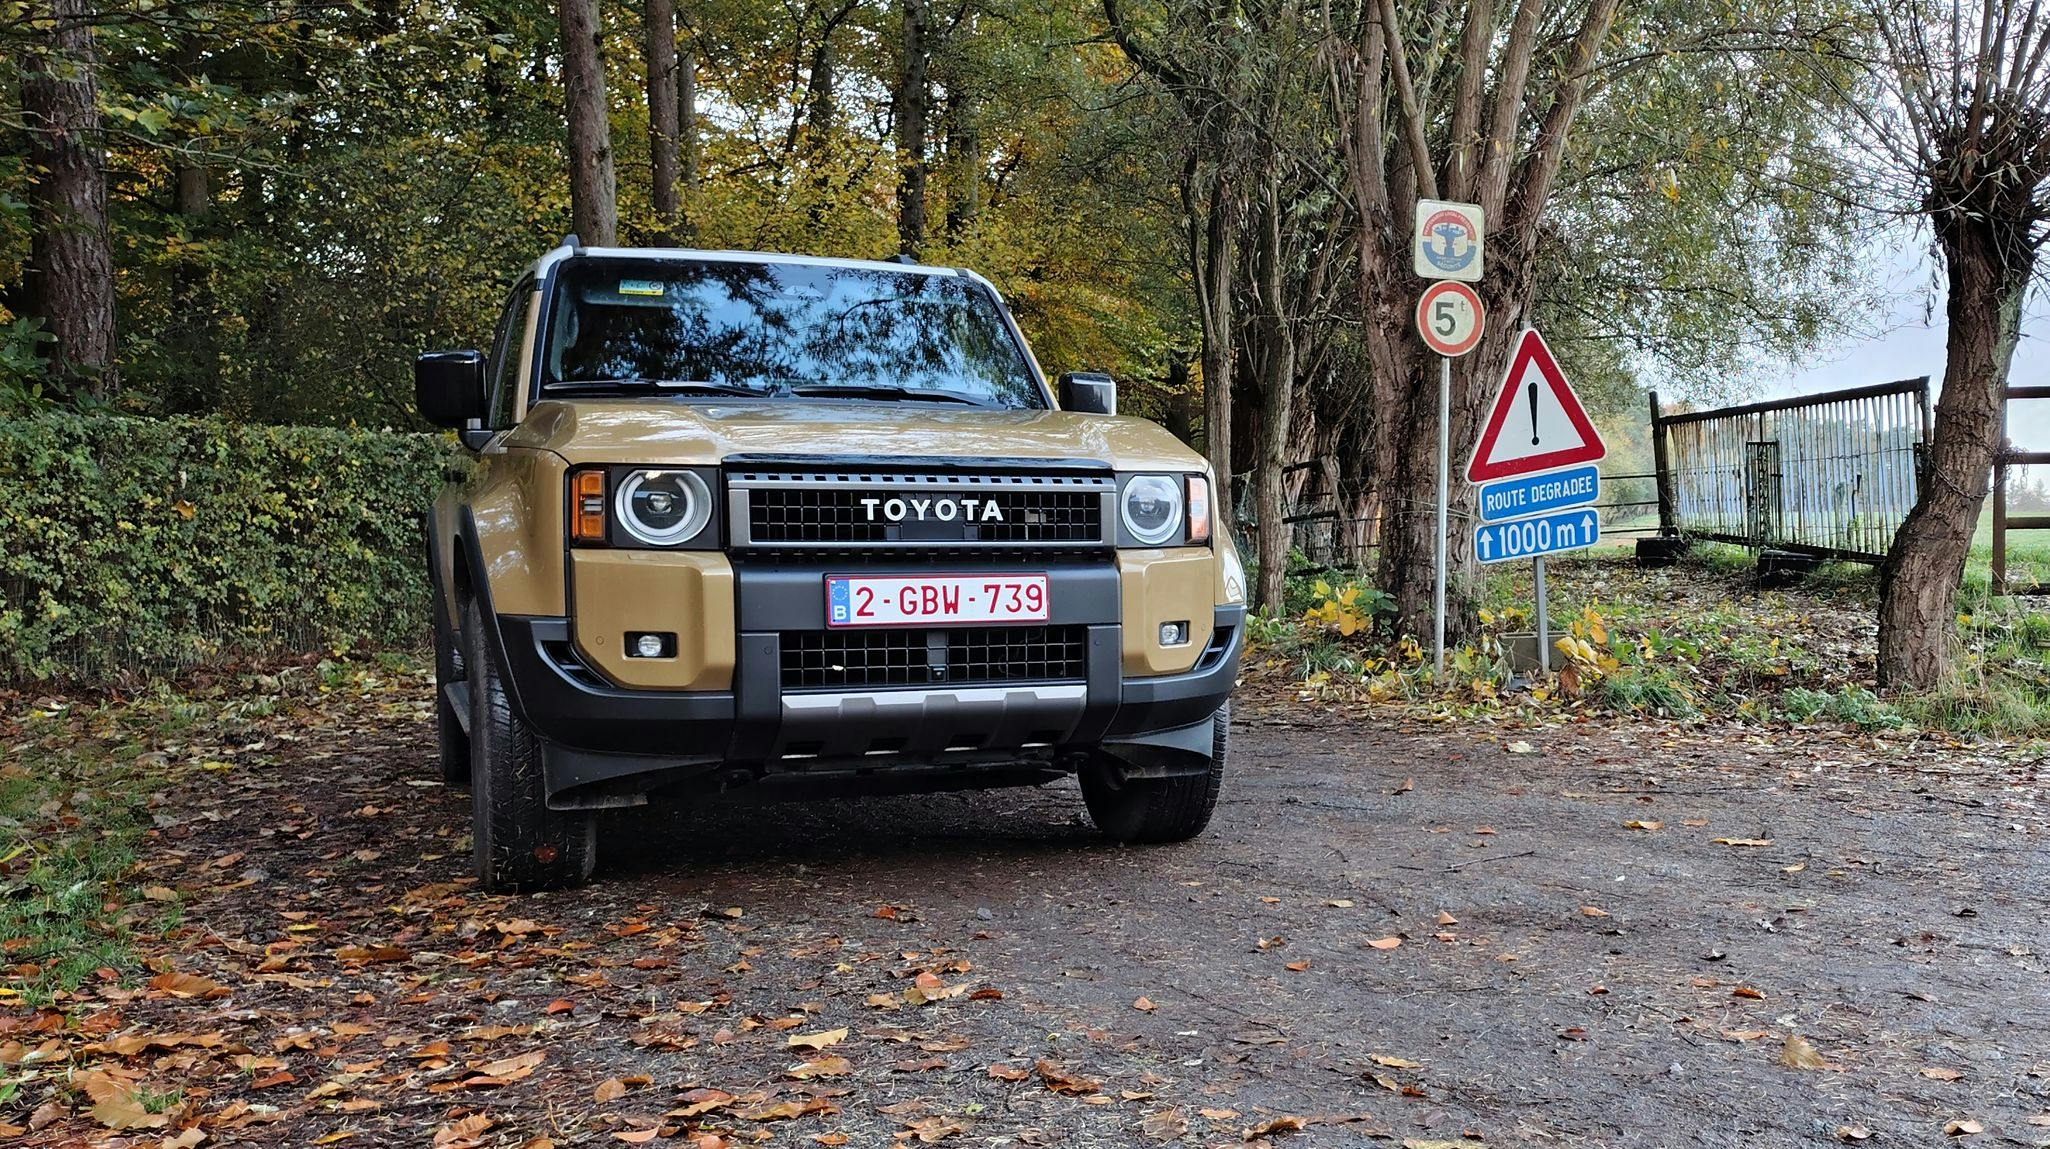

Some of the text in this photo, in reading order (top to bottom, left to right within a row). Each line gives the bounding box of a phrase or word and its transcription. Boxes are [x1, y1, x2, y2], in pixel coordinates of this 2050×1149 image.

[1435, 300, 1466, 337] 5 t
[860, 498, 1004, 521] TOYOTA
[1486, 475, 1593, 512] ROUTE DEGRADEE
[1498, 519, 1576, 557] 1000 m
[833, 604, 847, 620] B
[855, 583, 1043, 617] 2-GBW-739
